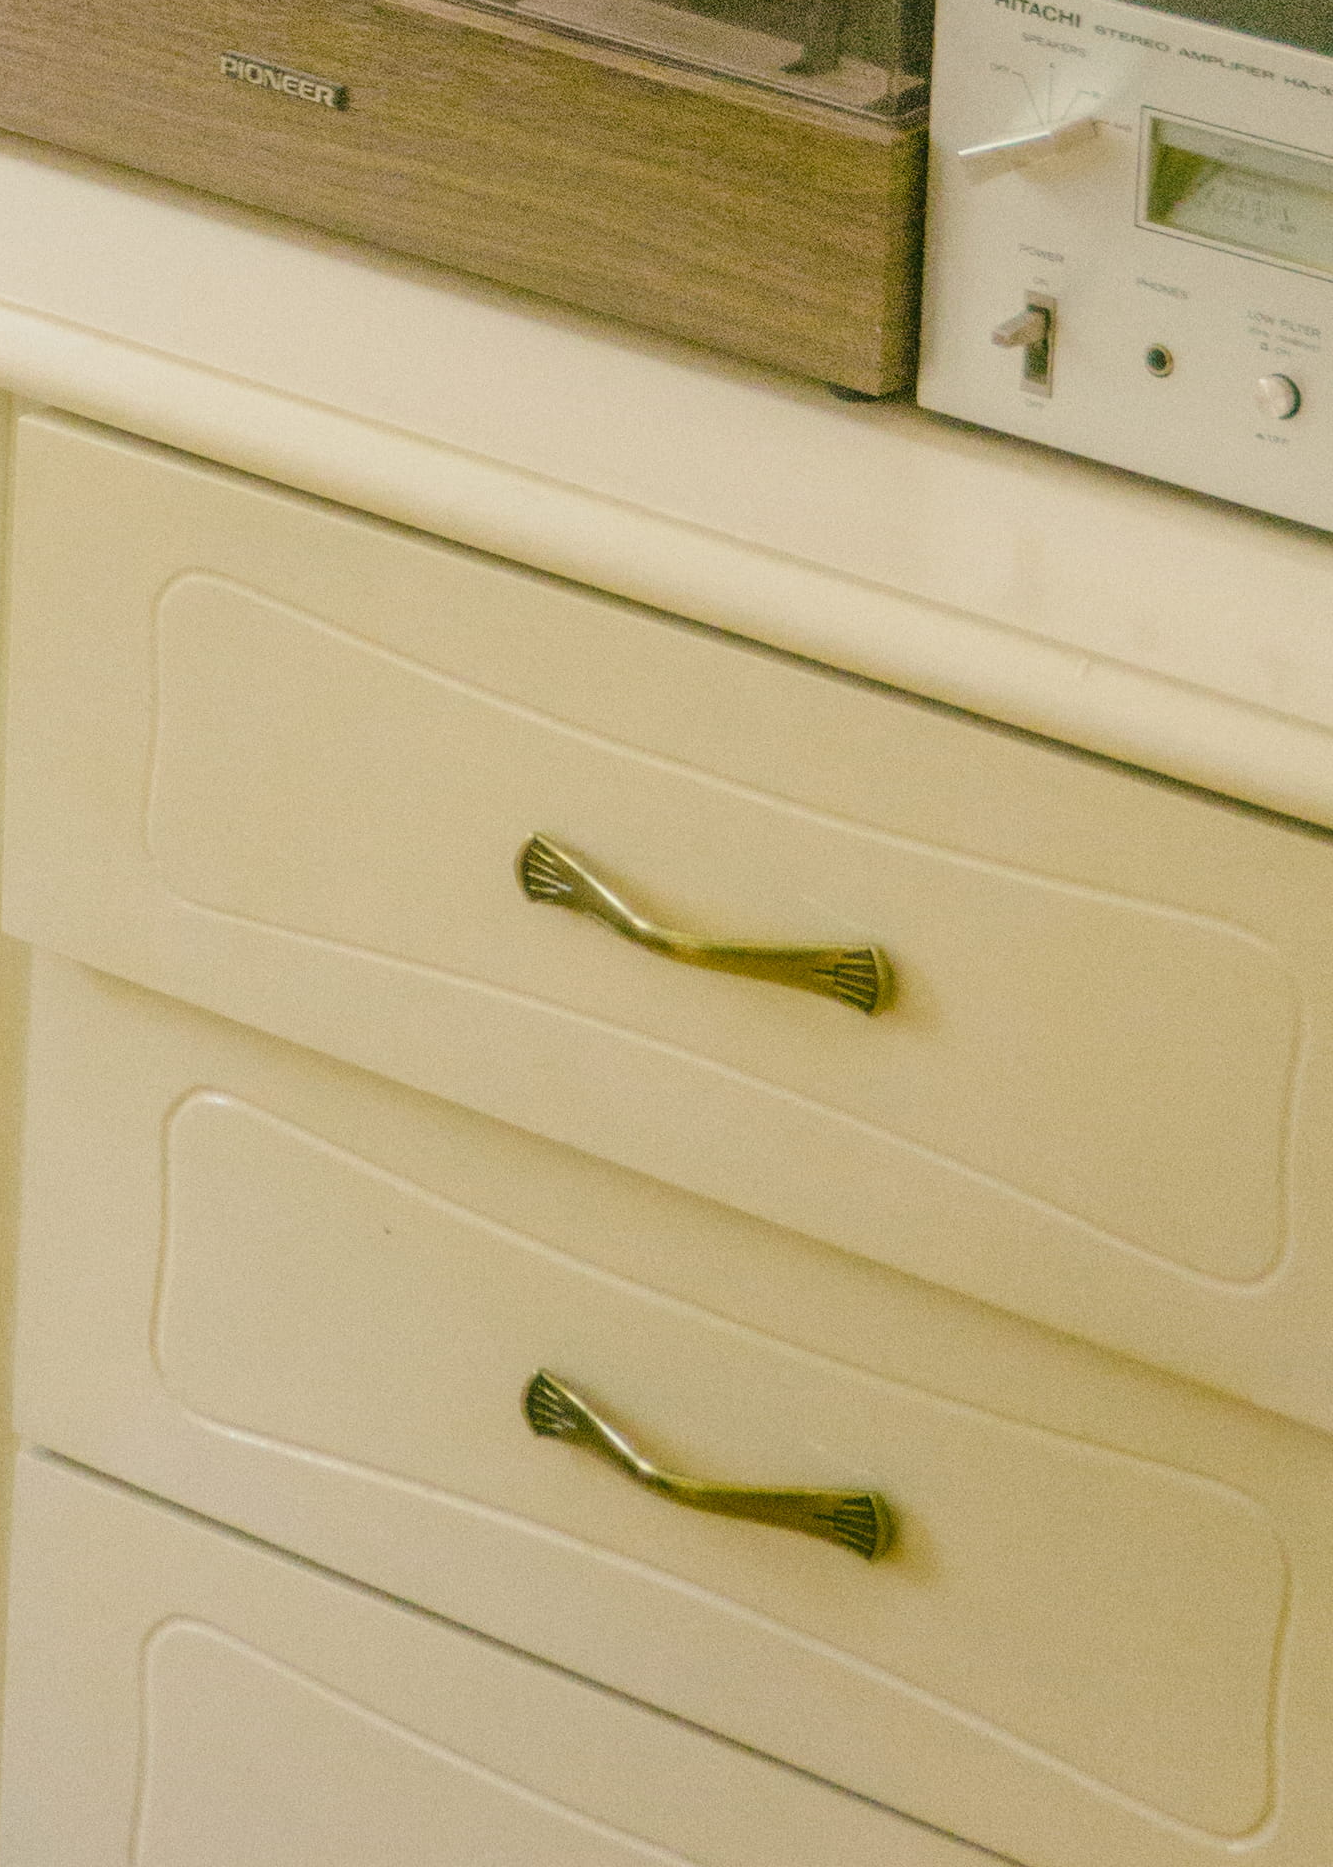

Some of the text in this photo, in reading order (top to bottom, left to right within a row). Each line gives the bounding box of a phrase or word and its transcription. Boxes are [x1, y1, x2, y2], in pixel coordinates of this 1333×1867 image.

[1021, 31, 1086, 58] SPEAKERS
[1095, 24, 1171, 52] STEREO
[1179, 47, 1276, 81] AMPLIFIER
[220, 55, 335, 107] PIONEER
